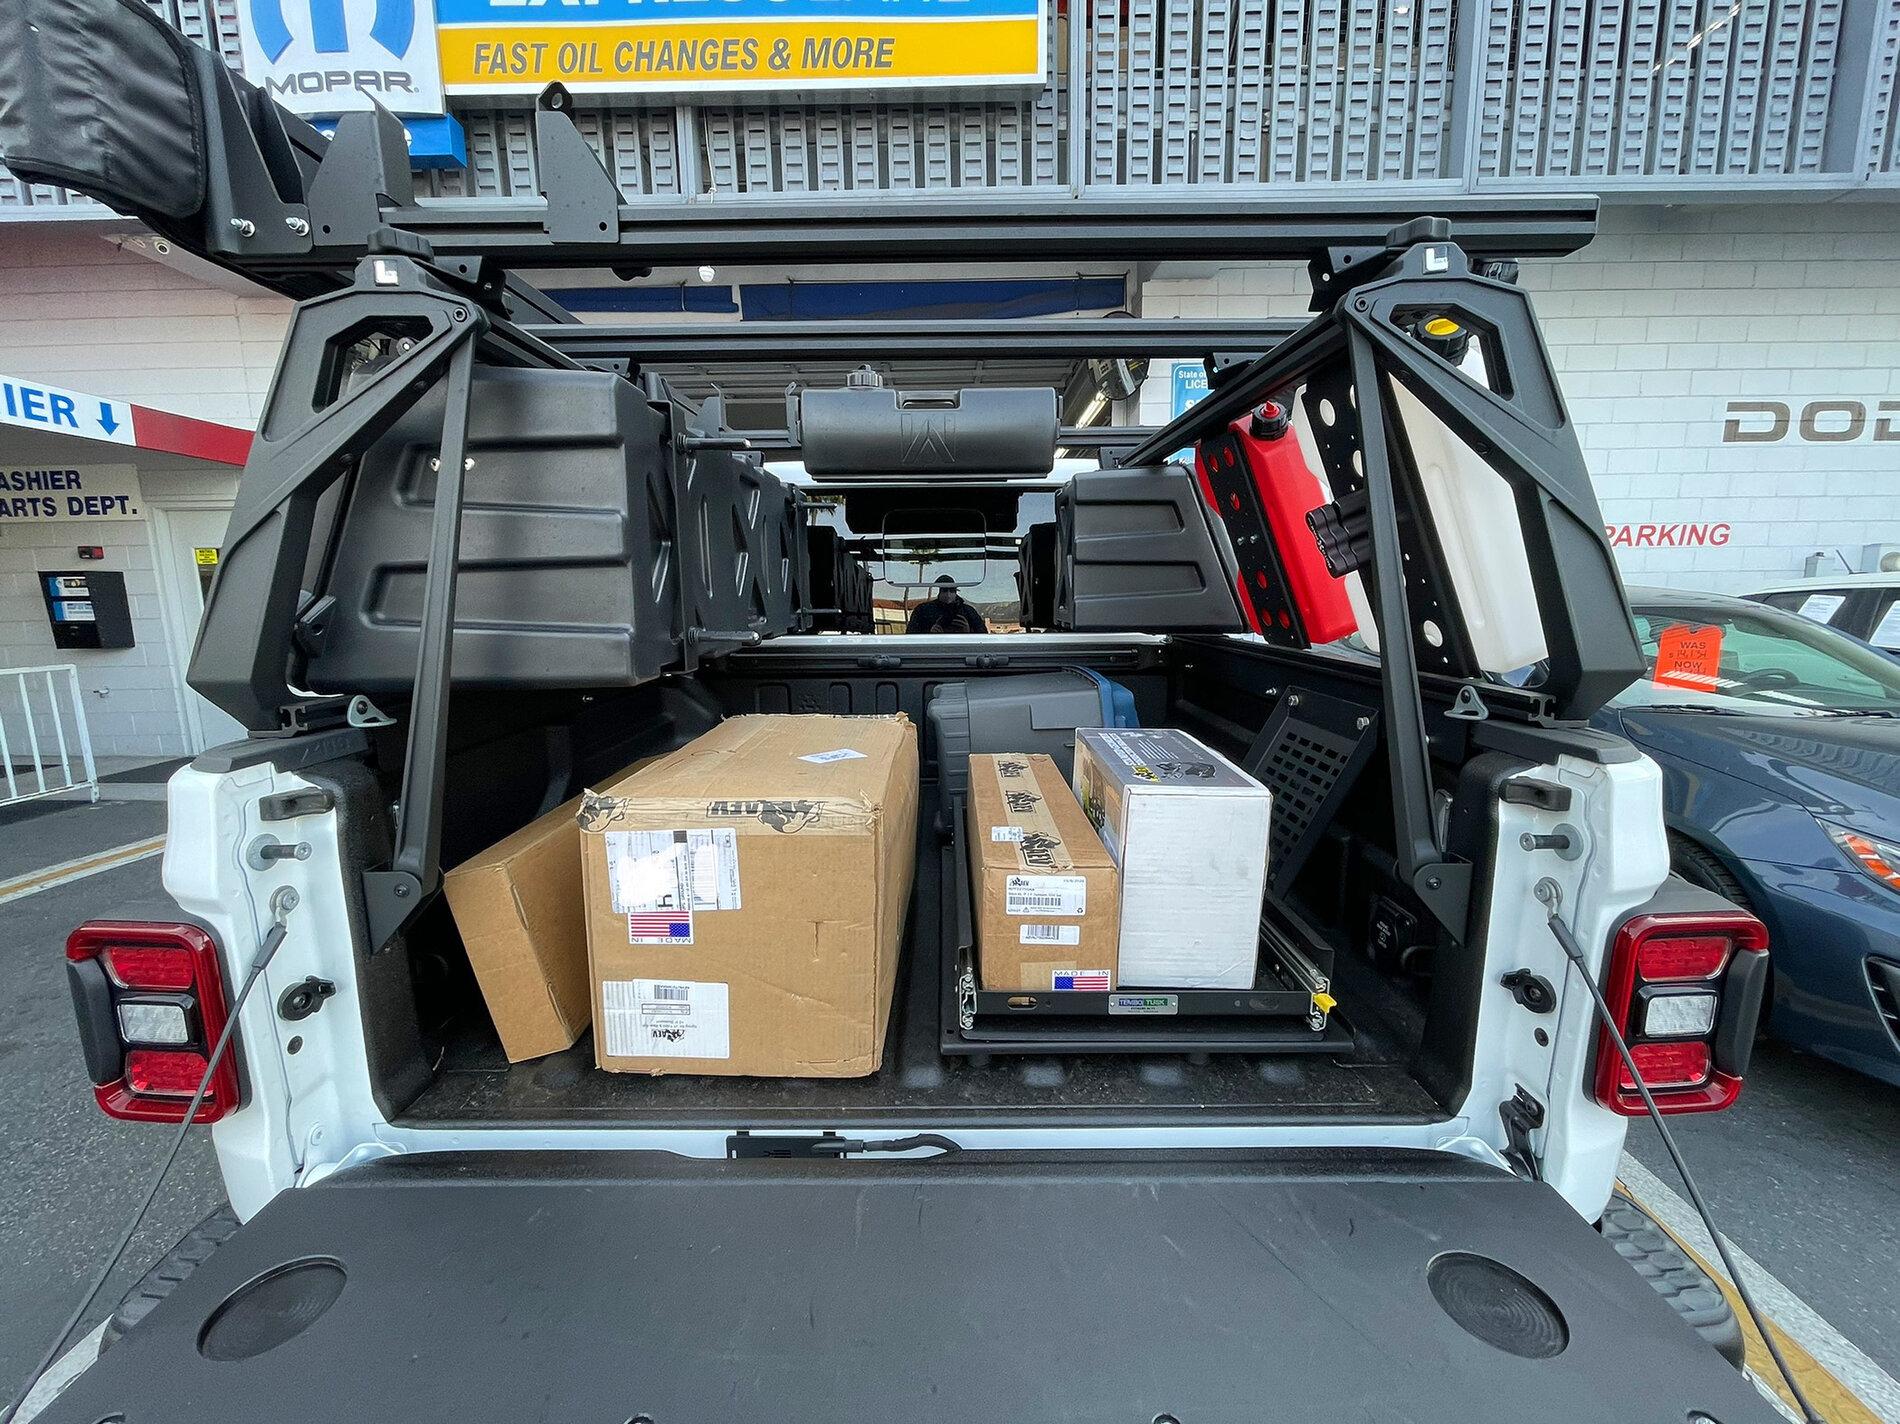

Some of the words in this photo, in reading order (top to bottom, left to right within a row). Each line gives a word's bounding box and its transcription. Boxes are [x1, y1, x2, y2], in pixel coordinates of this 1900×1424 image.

[473, 42, 549, 75] FAST
[557, 42, 604, 74] OIL
[613, 38, 759, 73] CHANGES
[767, 38, 791, 71] &
[800, 36, 896, 70] MORE
[1178, 370, 1198, 379] State
[67, 495, 138, 516] DEPT.
[1680, 641, 1706, 650] WAS
[1674, 660, 1703, 669] NOW
